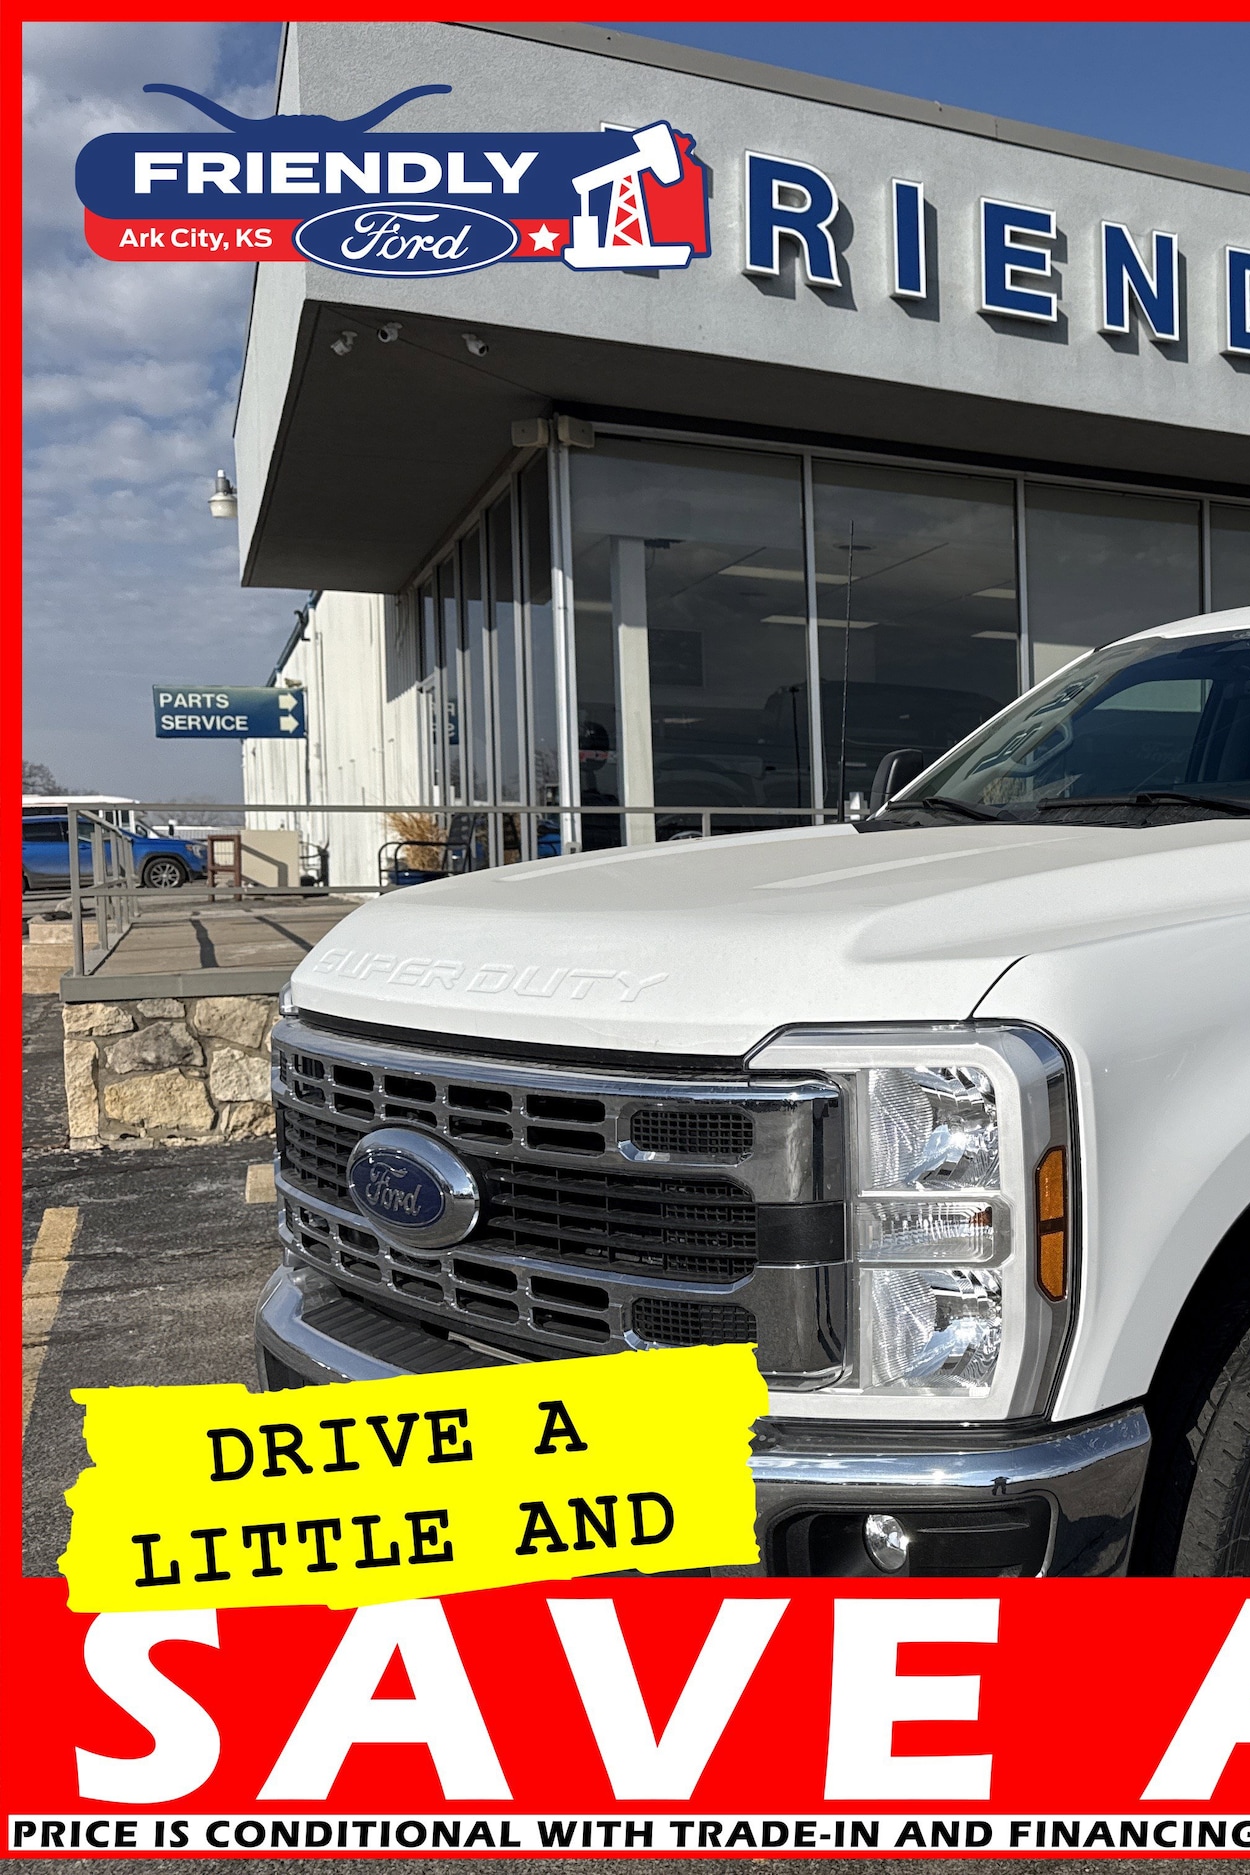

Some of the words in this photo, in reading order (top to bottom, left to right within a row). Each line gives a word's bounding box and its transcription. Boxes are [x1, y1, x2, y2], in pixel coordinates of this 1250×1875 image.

[159, 692, 230, 709] PARTS
[161, 714, 249, 732] SERVICE
[313, 947, 466, 991] SUPER
[466, 962, 670, 1003] DUTY
[365, 1161, 423, 1217] Ford
